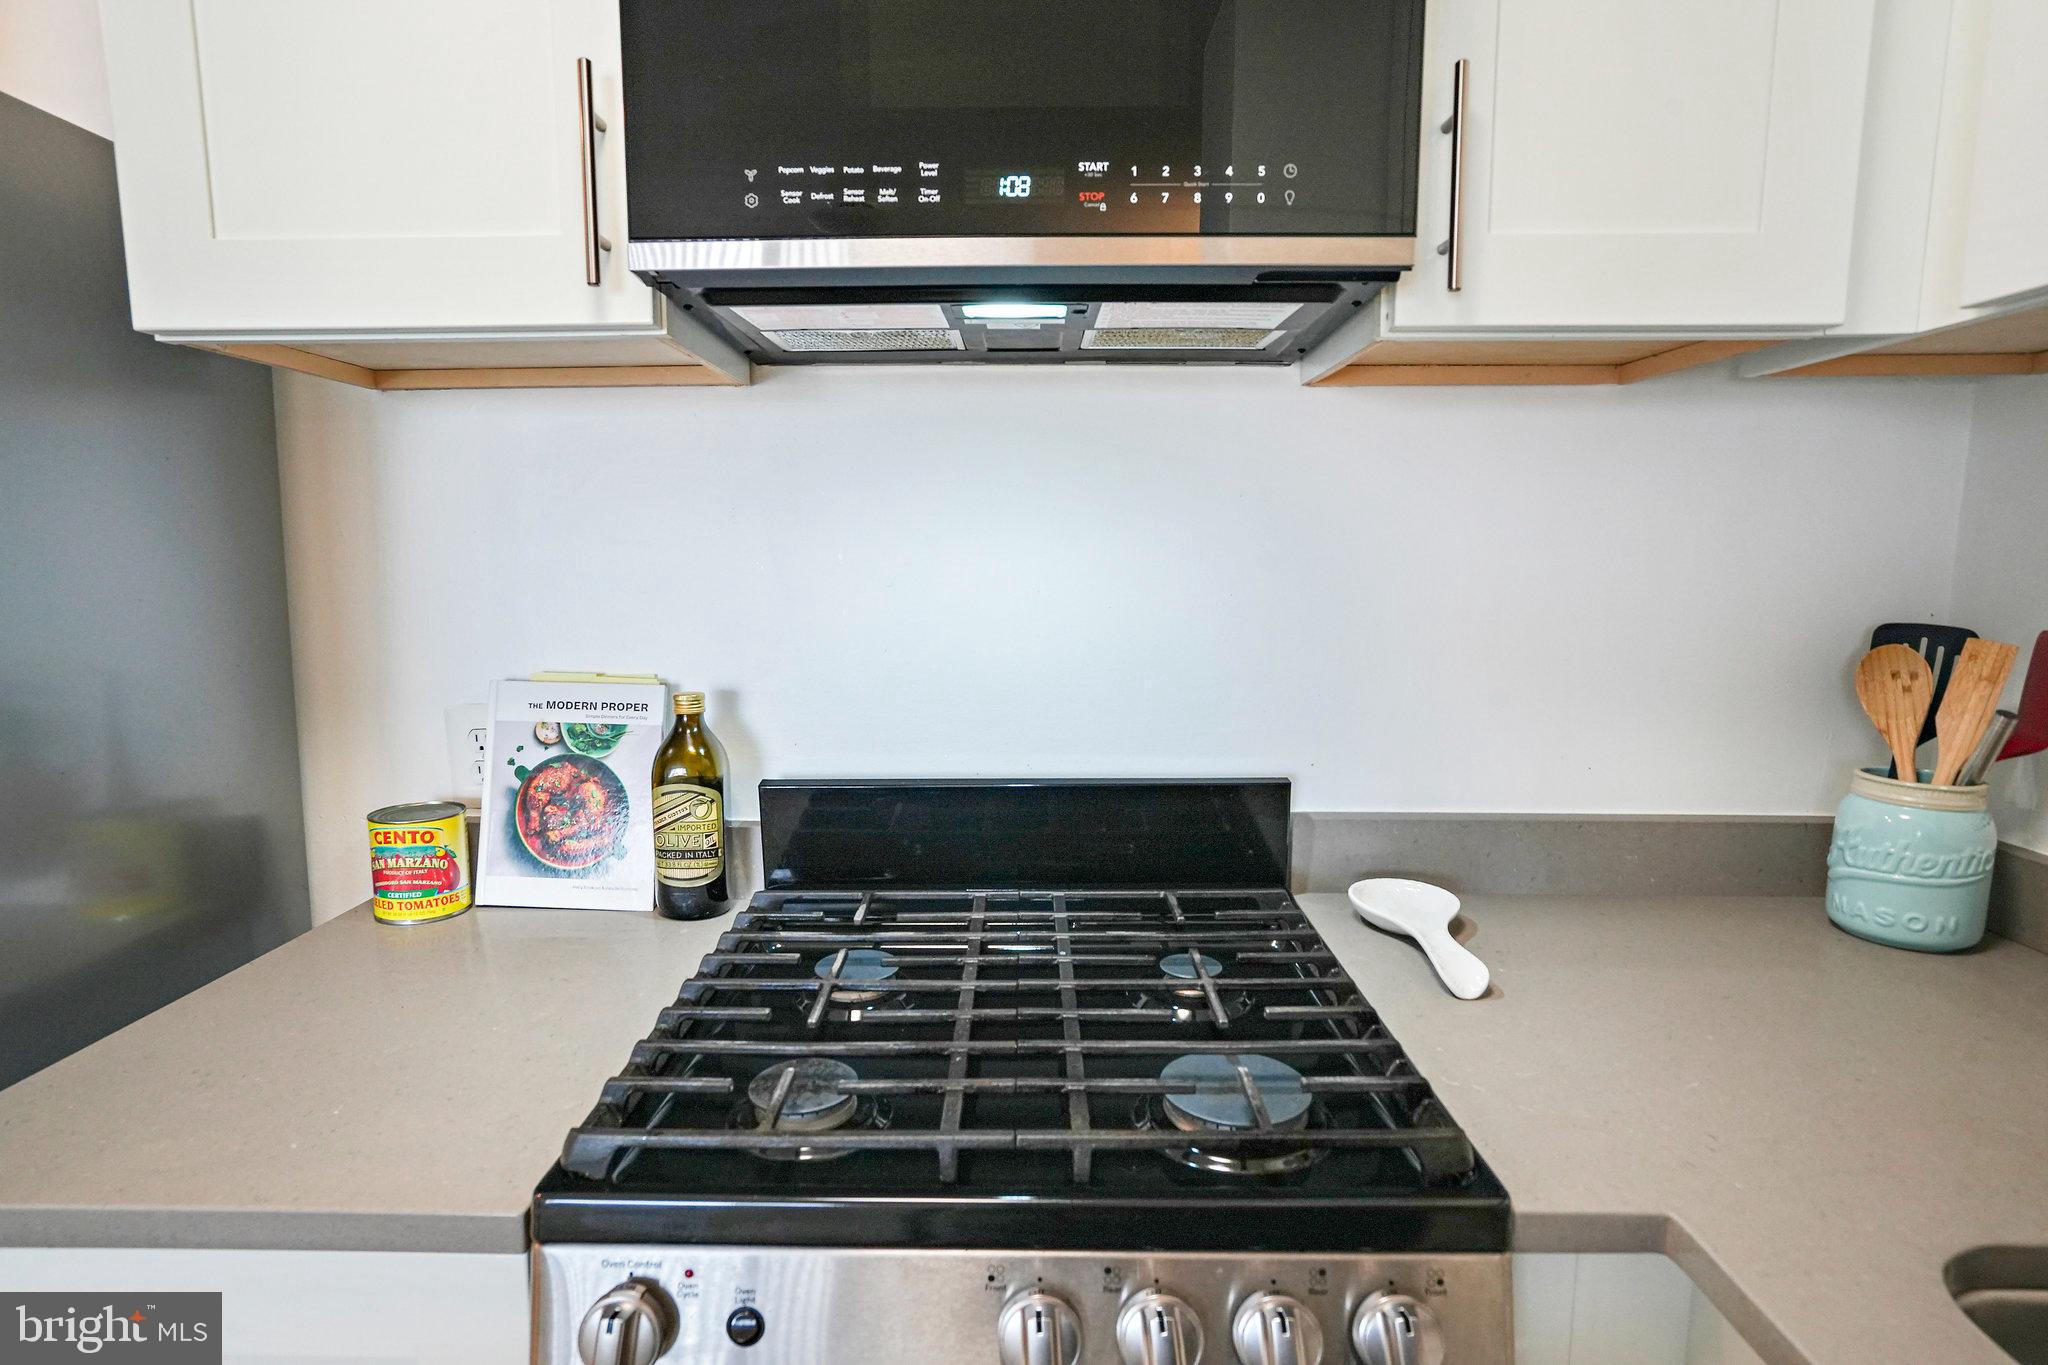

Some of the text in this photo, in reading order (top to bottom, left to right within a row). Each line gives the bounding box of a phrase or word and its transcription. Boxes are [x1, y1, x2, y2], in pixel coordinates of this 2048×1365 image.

[778, 166, 804, 176] Popcorn
[809, 166, 835, 175] Veggies
[843, 166, 864, 174] Potato
[872, 165, 902, 174] Beverage
[1078, 162, 1110, 172] START
[1131, 165, 1266, 177] 1 2 3 4 5
[920, 169, 938, 177] Level
[999, 176, 1030, 197] 1:08
[810, 192, 834, 200] Defrost
[1079, 192, 1105, 201] STOP
[1130, 192, 1265, 204] 6 7 8 9 0
[546, 701, 598, 710] MODERN
[601, 702, 648, 712] PROPER
[678, 823, 716, 831] IMPORTED
[374, 831, 434, 844] CENTO
[656, 834, 701, 847] OLIVE
[705, 836, 716, 846] OIL
[656, 851, 682, 859] PACKED
[372, 858, 448, 871] SAN MARZANO
[397, 892, 460, 910] TOMATOES
[1832, 892, 1962, 936] MASON
[602, 1259, 662, 1268] Oven Control
